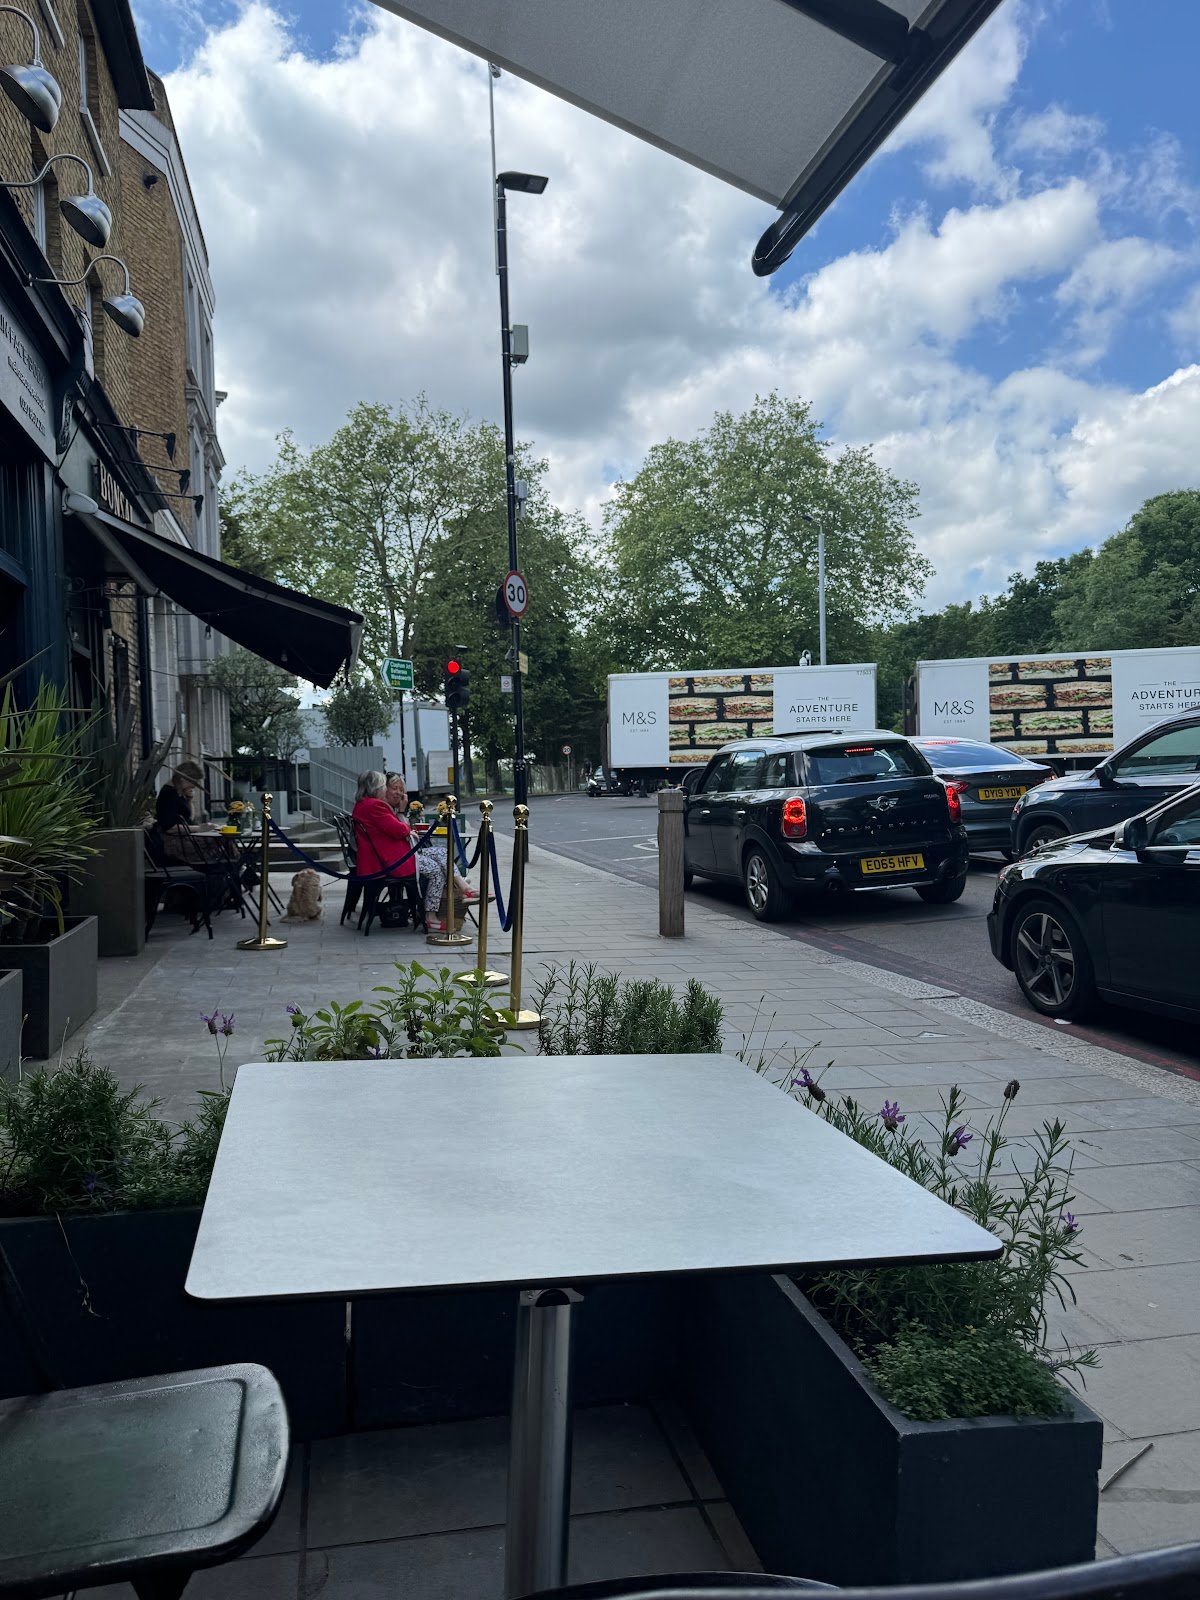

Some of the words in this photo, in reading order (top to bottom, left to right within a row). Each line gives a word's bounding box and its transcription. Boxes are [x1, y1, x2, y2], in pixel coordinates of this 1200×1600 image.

[100, 459, 133, 522] BONSAI
[508, 583, 525, 604] 30
[789, 703, 859, 714] ADVENTURE
[934, 699, 975, 716] M&S
[1139, 702, 1174, 710] STARTS
[622, 711, 657, 726] M&S
[984, 789, 1004, 799] DY19
[897, 855, 918, 868] HFV
